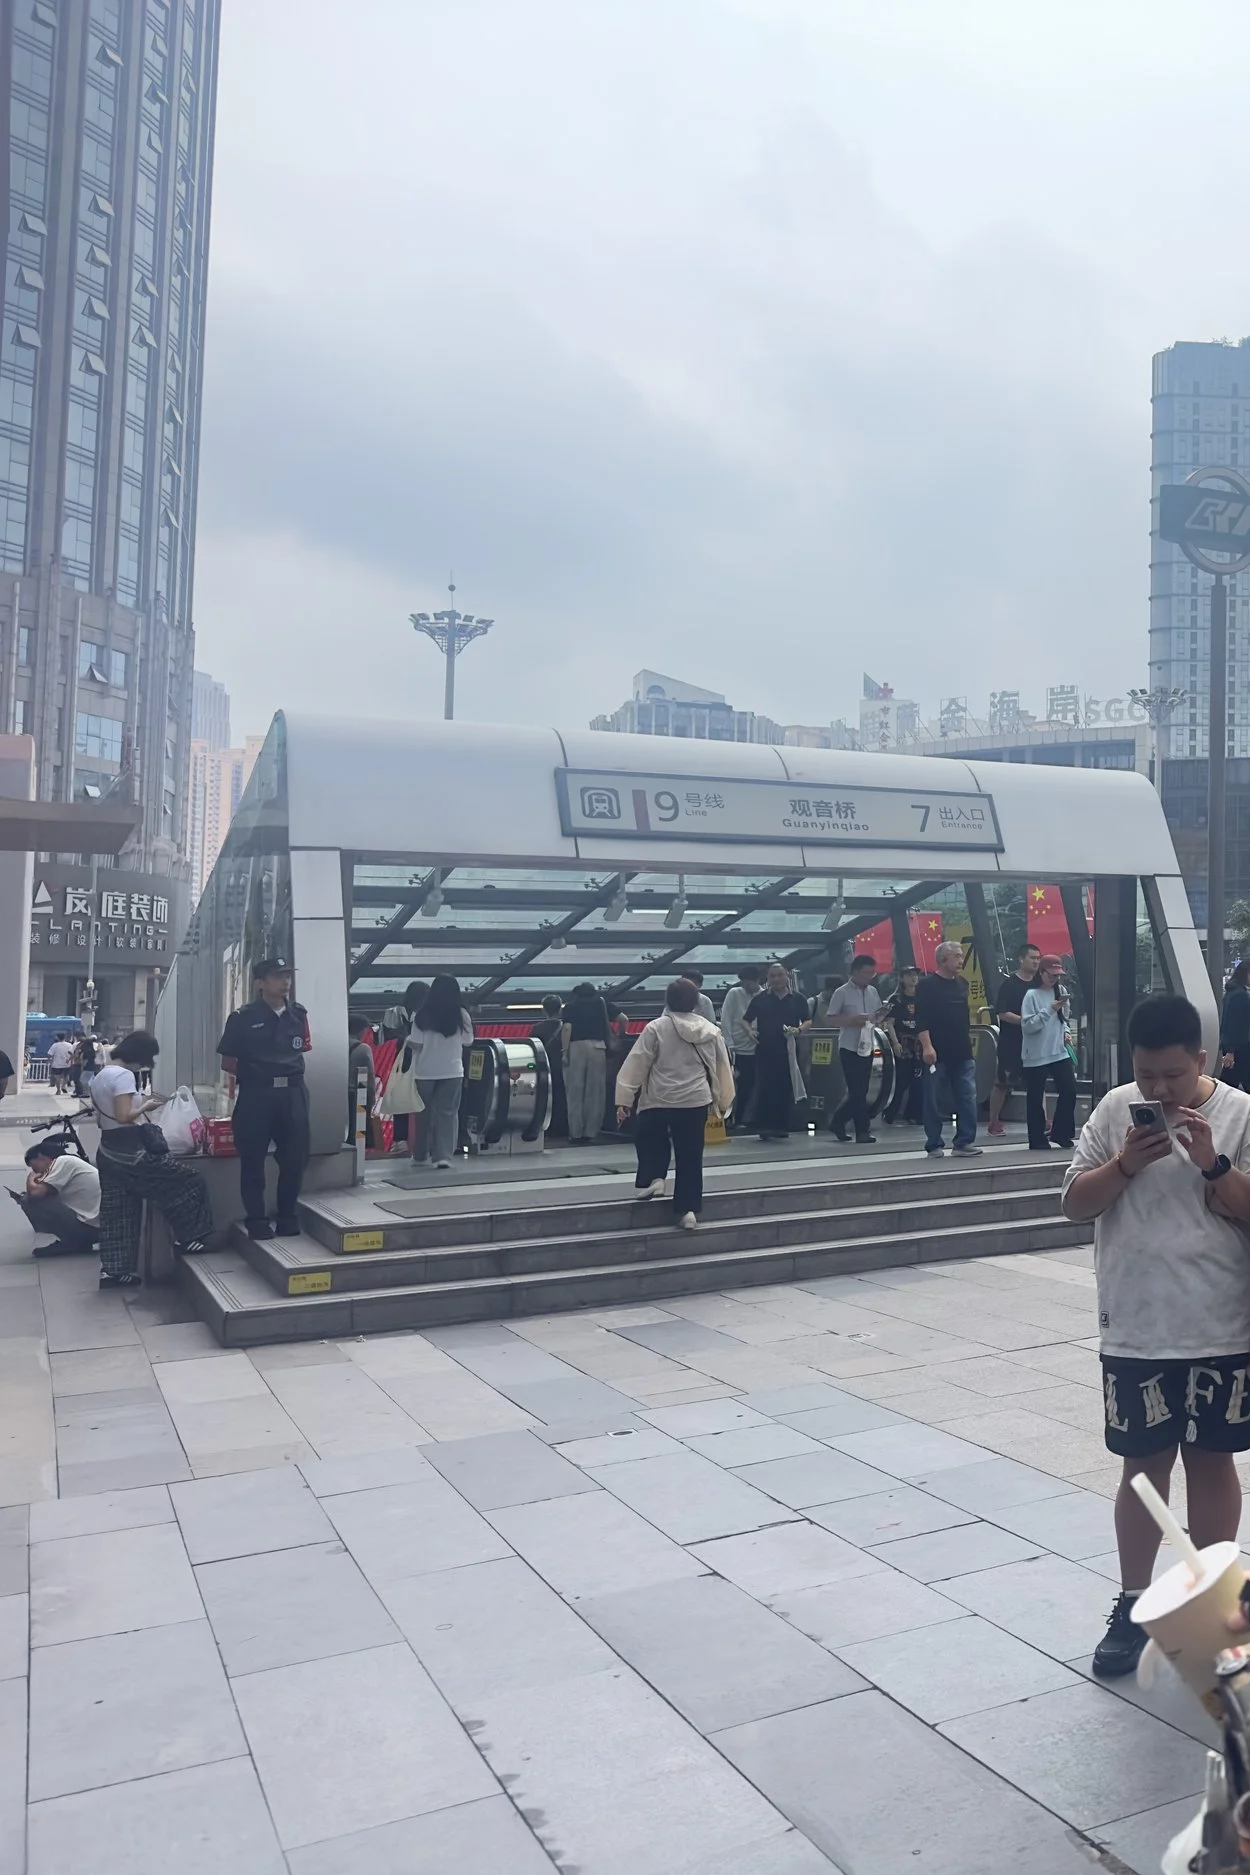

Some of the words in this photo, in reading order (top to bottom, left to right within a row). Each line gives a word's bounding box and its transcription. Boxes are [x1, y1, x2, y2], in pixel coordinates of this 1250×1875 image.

[653, 790, 680, 822] 9
[684, 792, 725, 810] 号线
[788, 799, 857, 820] 观音桥
[684, 806, 709, 818] Line
[910, 804, 931, 833] 7
[939, 806, 986, 822] 出入口
[782, 817, 870, 832] Guanyinqiao
[941, 820, 984, 831] Entrance
[64, 886, 169, 924] 岚庭装饰
[1106, 1366, 1250, 1433] LIFE
